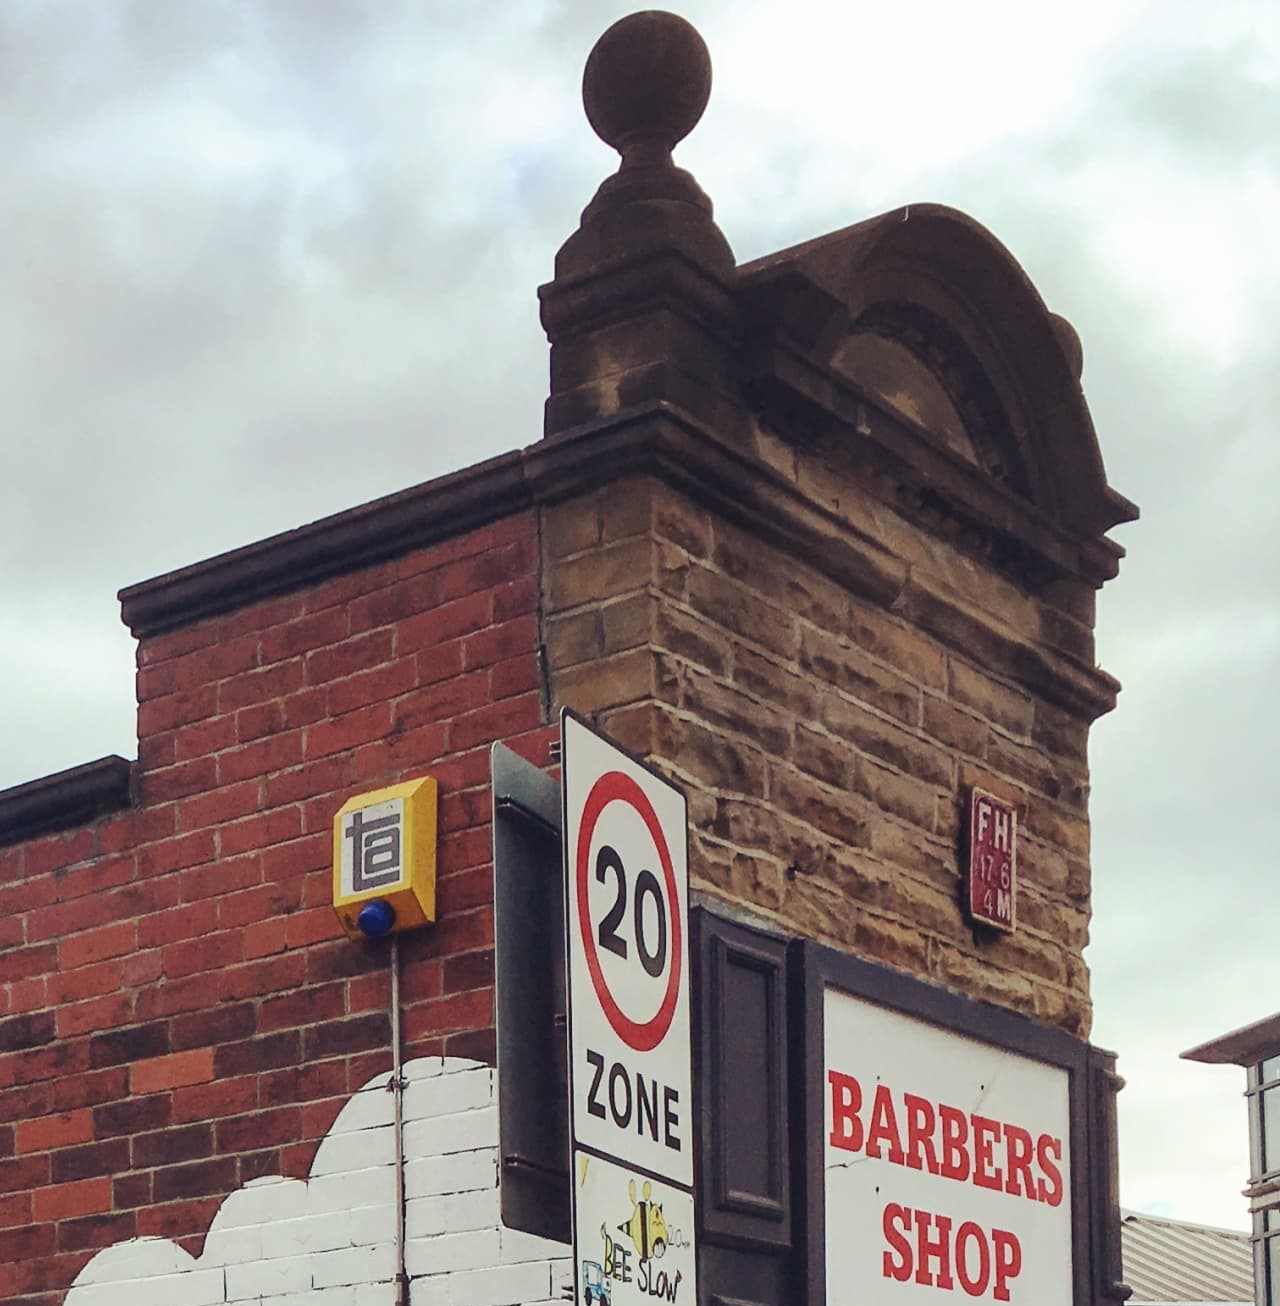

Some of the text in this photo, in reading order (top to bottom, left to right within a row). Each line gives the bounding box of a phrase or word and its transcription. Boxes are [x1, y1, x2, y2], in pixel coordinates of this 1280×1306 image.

[596, 844, 667, 978] 20
[997, 889, 1010, 921] M
[586, 1048, 682, 1152] ZONE
[829, 1070, 1064, 1207] BARBERS
[605, 1234, 682, 1304] BEE SLOW
[883, 1202, 1022, 1302] SHOP
